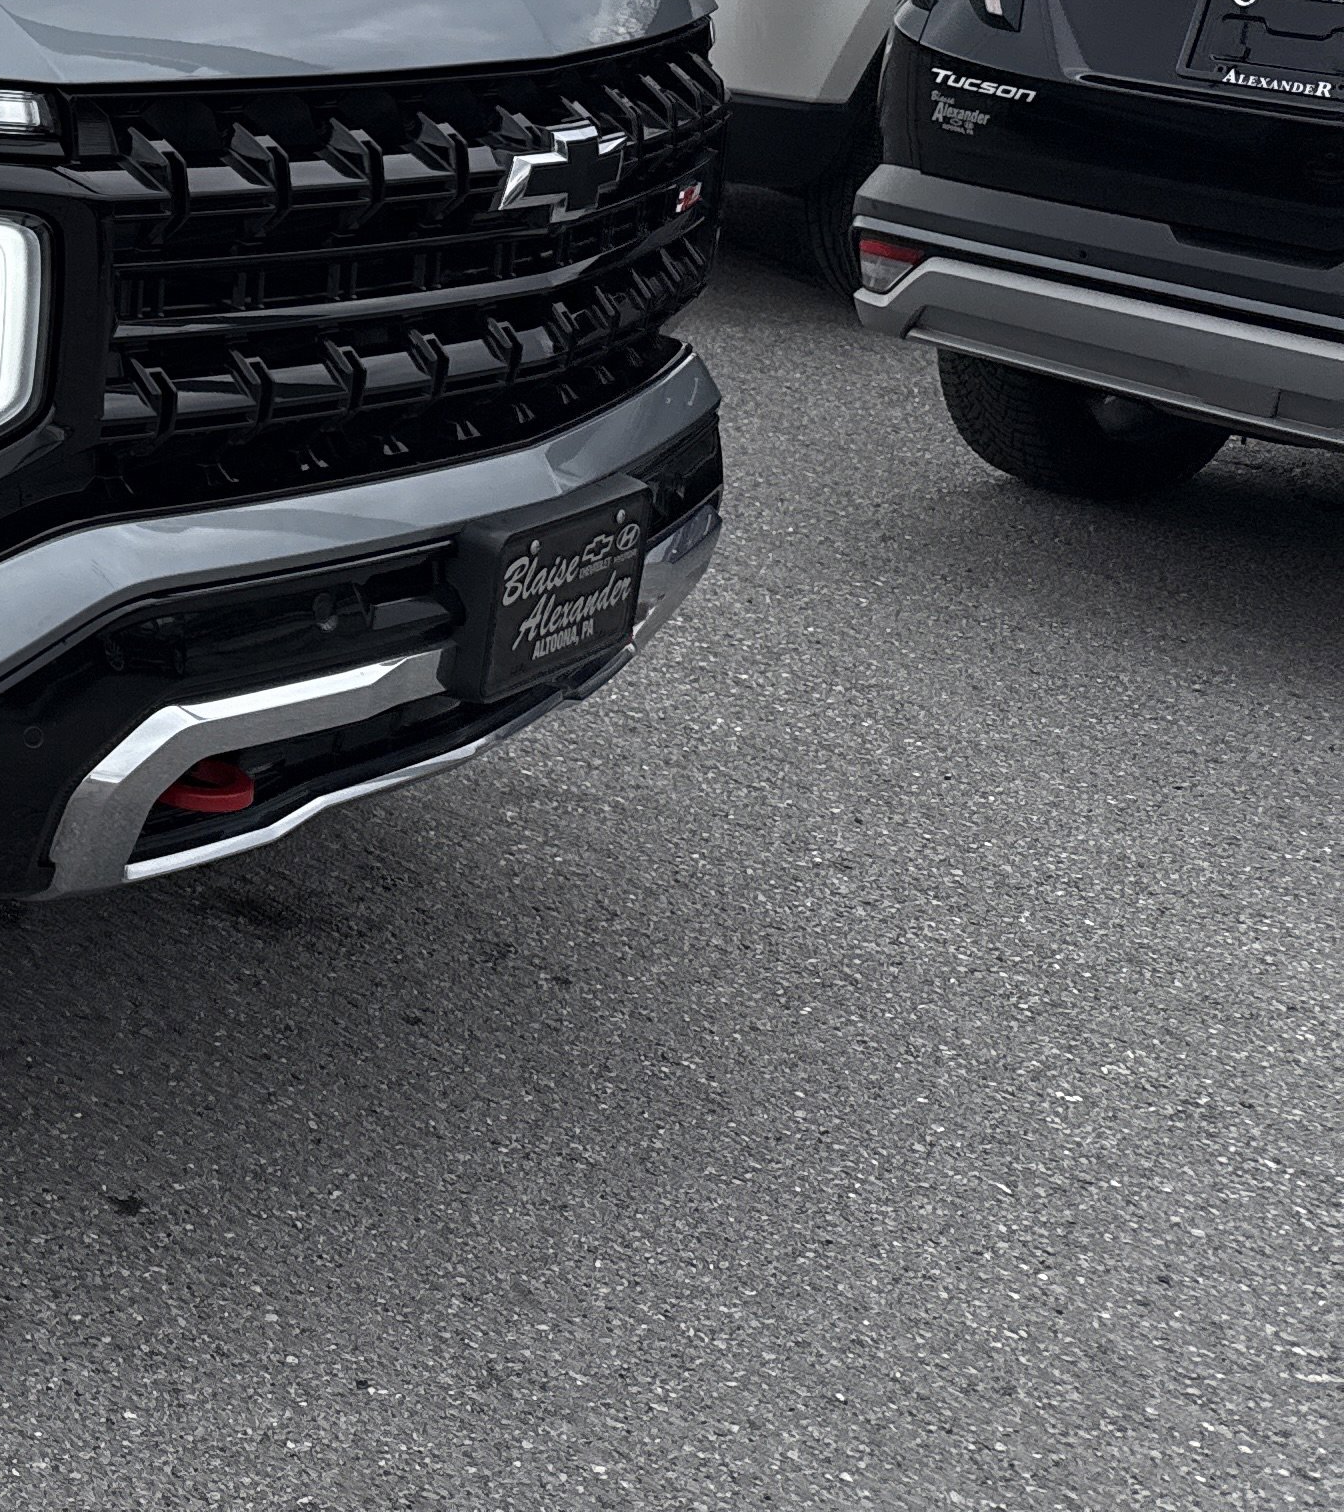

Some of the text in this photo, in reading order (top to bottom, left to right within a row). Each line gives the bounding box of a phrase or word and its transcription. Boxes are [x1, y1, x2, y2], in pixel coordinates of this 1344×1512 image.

[1222, 68, 1333, 98] ALEXANDER
[932, 101, 991, 126] Alexander
[502, 555, 580, 606] Blaise
[512, 570, 632, 651] Alexander
[531, 618, 594, 661] ALTOONA, PA
